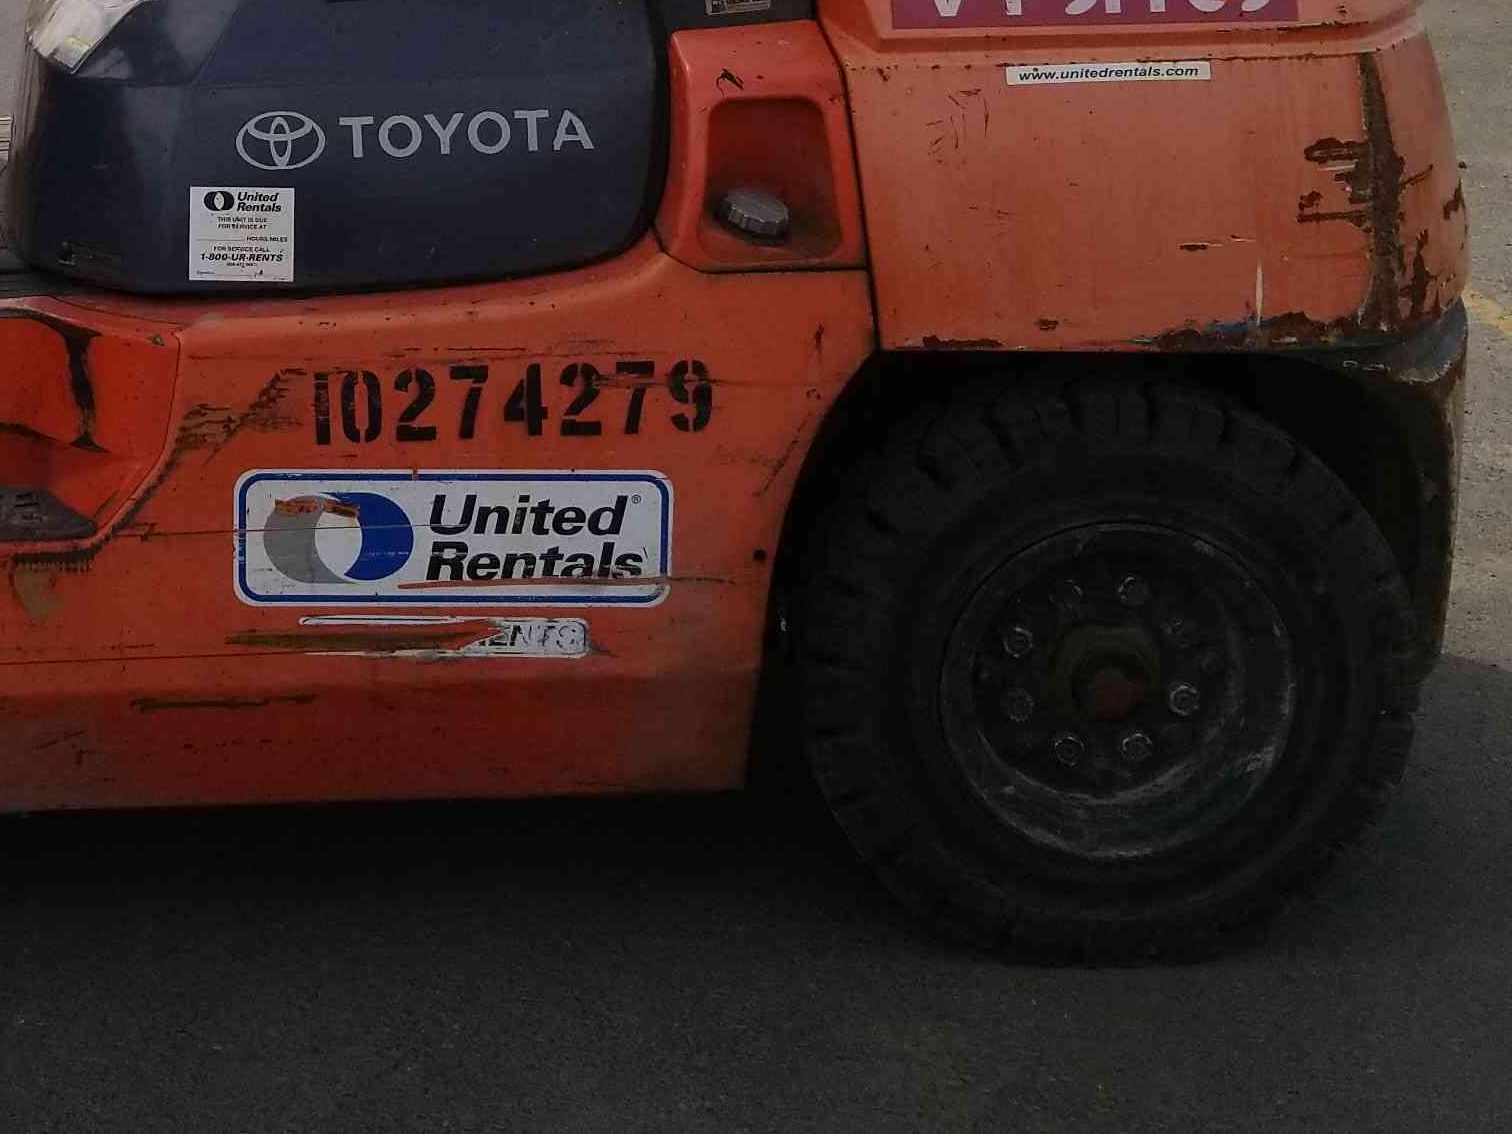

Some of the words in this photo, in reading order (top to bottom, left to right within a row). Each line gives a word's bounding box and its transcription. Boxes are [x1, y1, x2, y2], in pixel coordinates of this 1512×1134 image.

[1018, 64, 1200, 83] www.unitedrentals.com
[339, 109, 595, 158] TOYOTA
[237, 191, 280, 202] United
[236, 202, 282, 213] Rentals
[200, 252, 285, 263] 1-800-UR-RENTS
[313, 359, 714, 446] 10274279
[425, 540, 644, 581] Rentals
